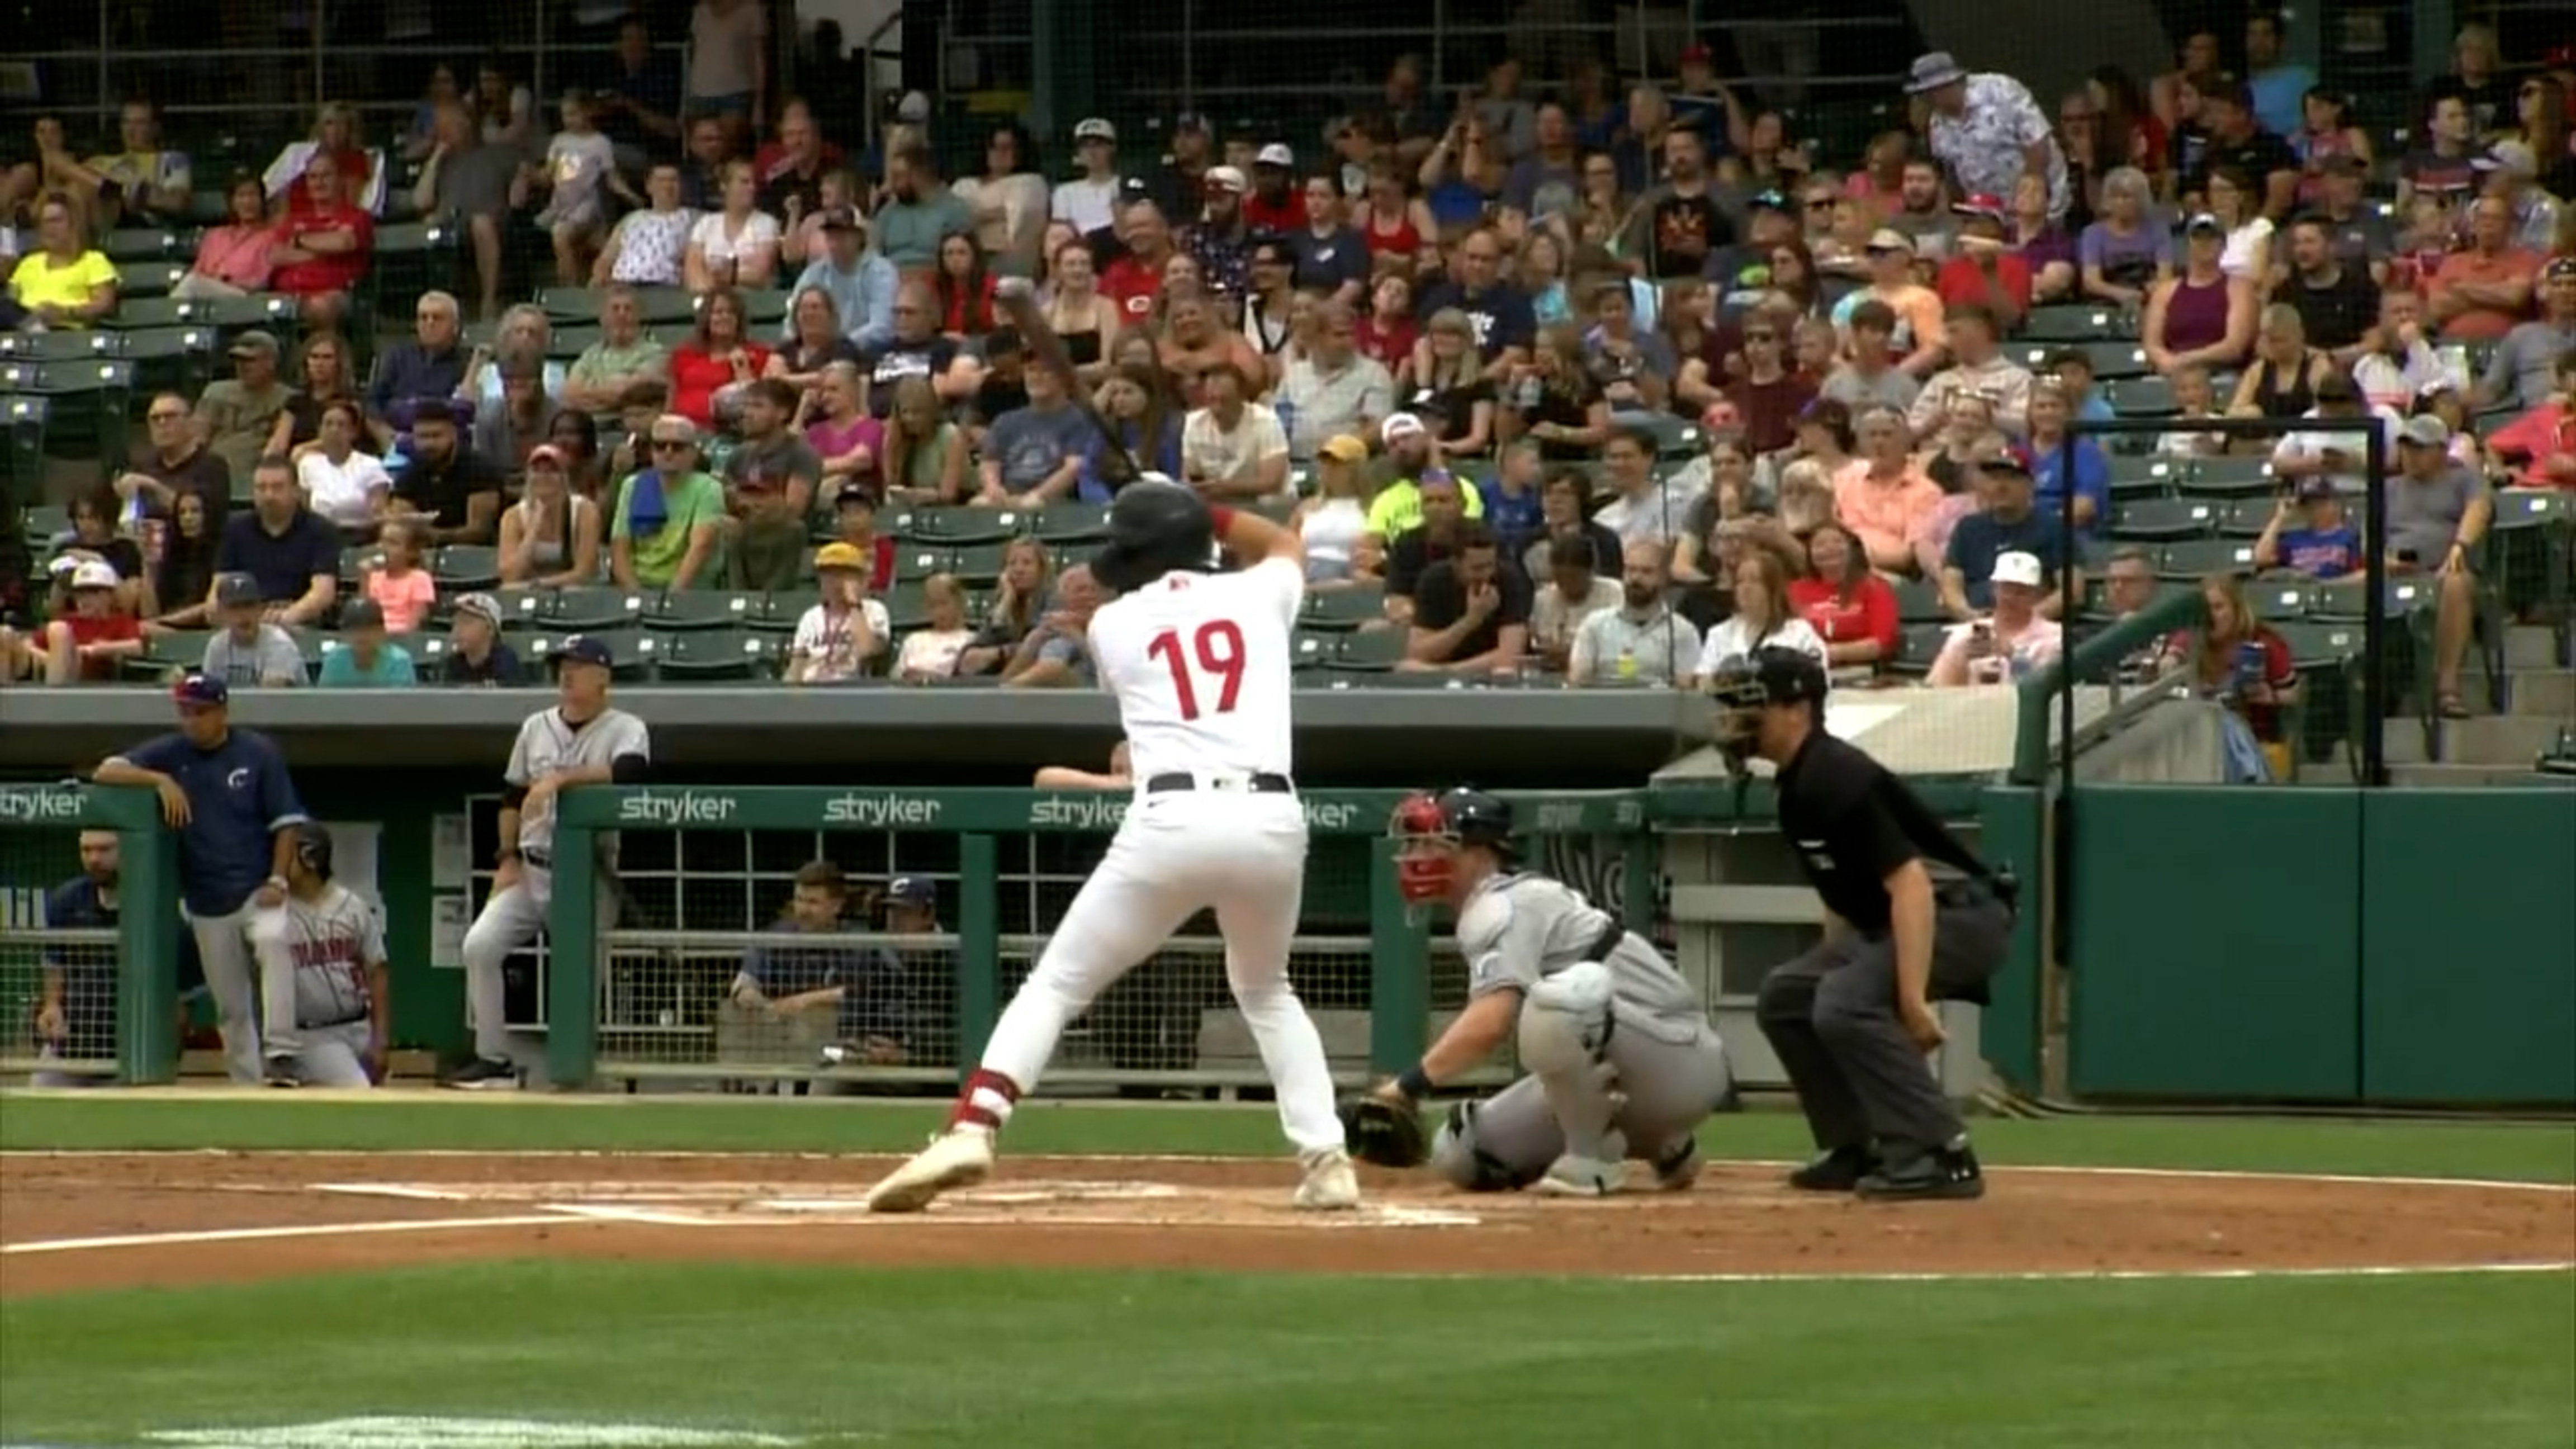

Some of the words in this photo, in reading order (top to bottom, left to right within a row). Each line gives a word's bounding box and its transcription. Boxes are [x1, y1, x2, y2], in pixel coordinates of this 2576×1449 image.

[1148, 619, 1246, 721] 19
[618, 787, 736, 825] stryker
[822, 792, 941, 826] stryker
